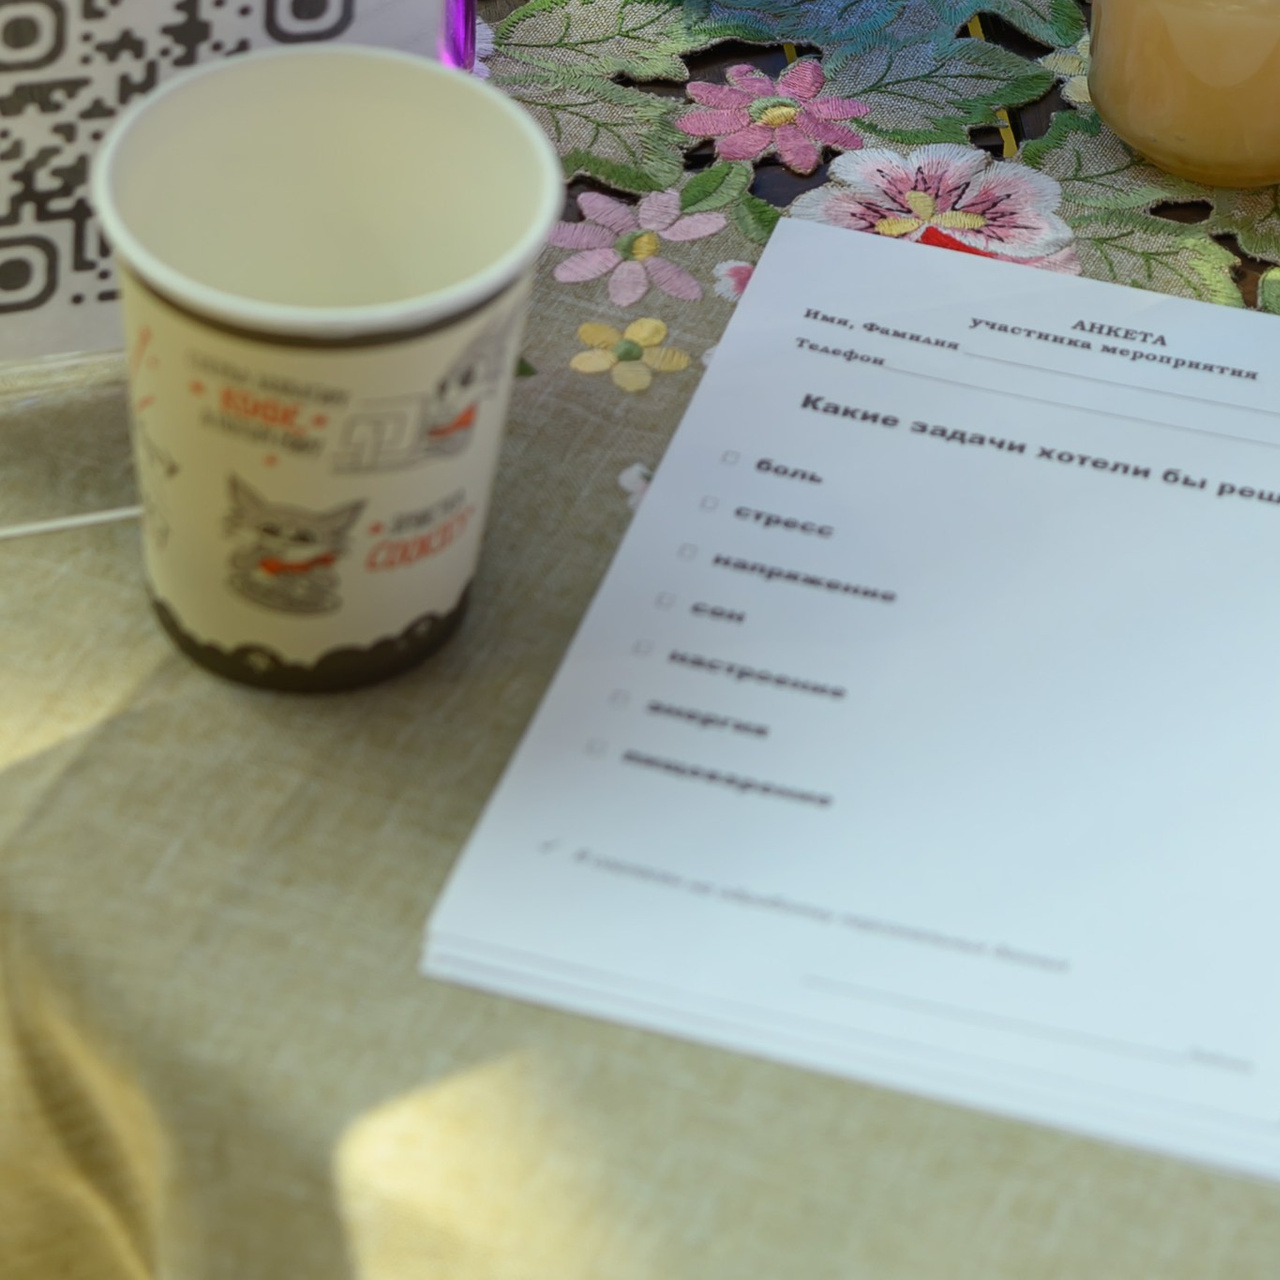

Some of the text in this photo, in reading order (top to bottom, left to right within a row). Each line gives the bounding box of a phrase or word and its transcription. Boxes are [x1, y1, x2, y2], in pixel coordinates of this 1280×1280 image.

[803, 307, 960, 353] Имя, Фамилия
[968, 316, 1259, 381] участника мероприятия
[1070, 318, 1168, 348] АНКЕТА
[795, 336, 886, 368] Телефон
[800, 392, 900, 430] Какие
[910, 419, 1026, 456] задачи
[1035, 444, 1151, 480] хотели
[1161, 466, 1207, 492] бы
[755, 454, 824, 486] боль
[733, 501, 834, 539] стресс
[711, 549, 897, 604] напряжение
[690, 598, 746, 625] сон
[667, 645, 847, 702] настроение
